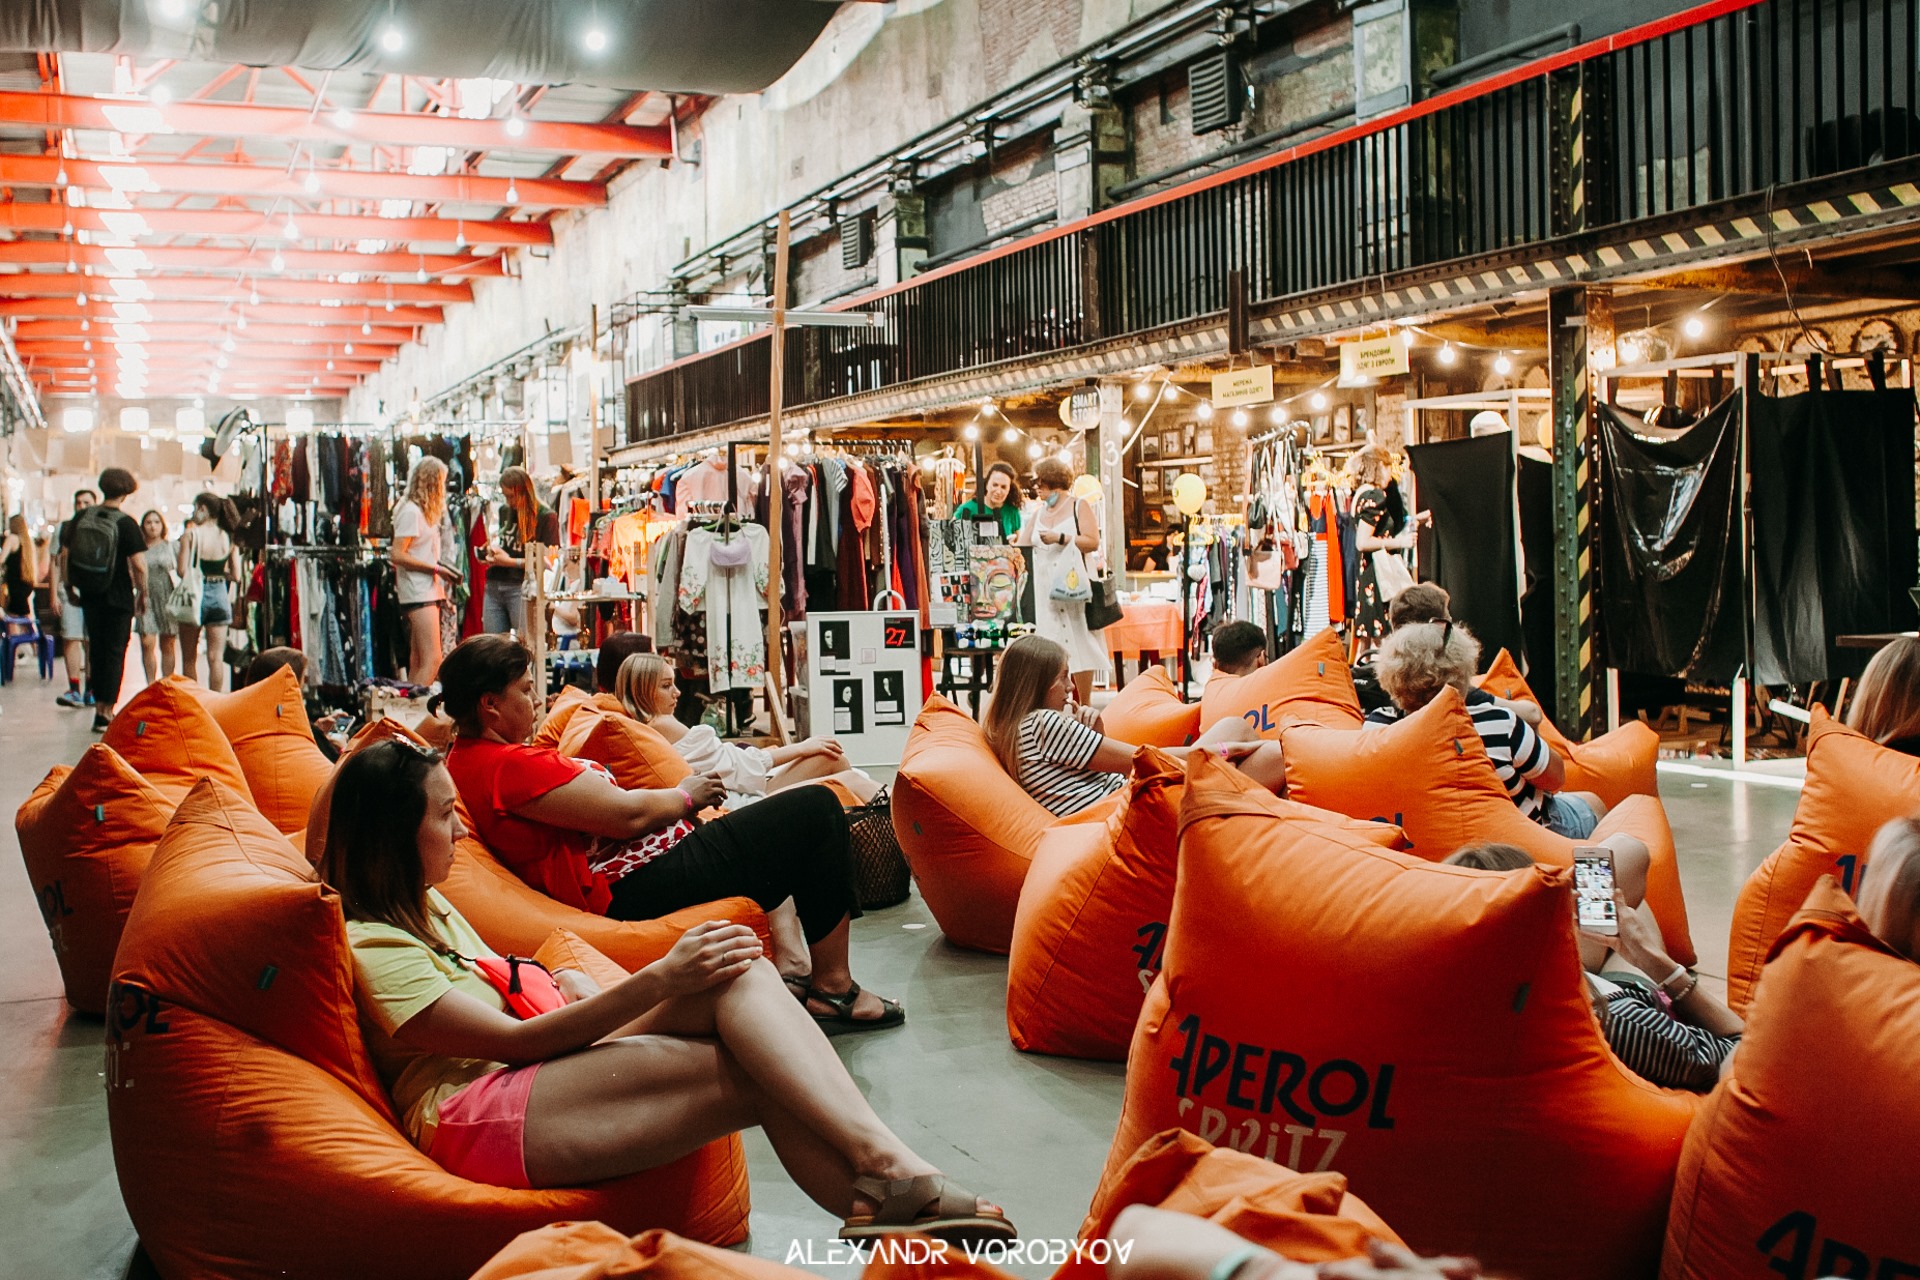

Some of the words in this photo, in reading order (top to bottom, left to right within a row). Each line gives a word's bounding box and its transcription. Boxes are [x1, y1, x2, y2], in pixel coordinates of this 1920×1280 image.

[1072, 392, 1098, 409] SMART
[1105, 440, 1119, 467] 3
[885, 627, 906, 647] 27
[1243, 704, 1276, 732] OL
[1169, 1013, 1395, 1130] APEROL
